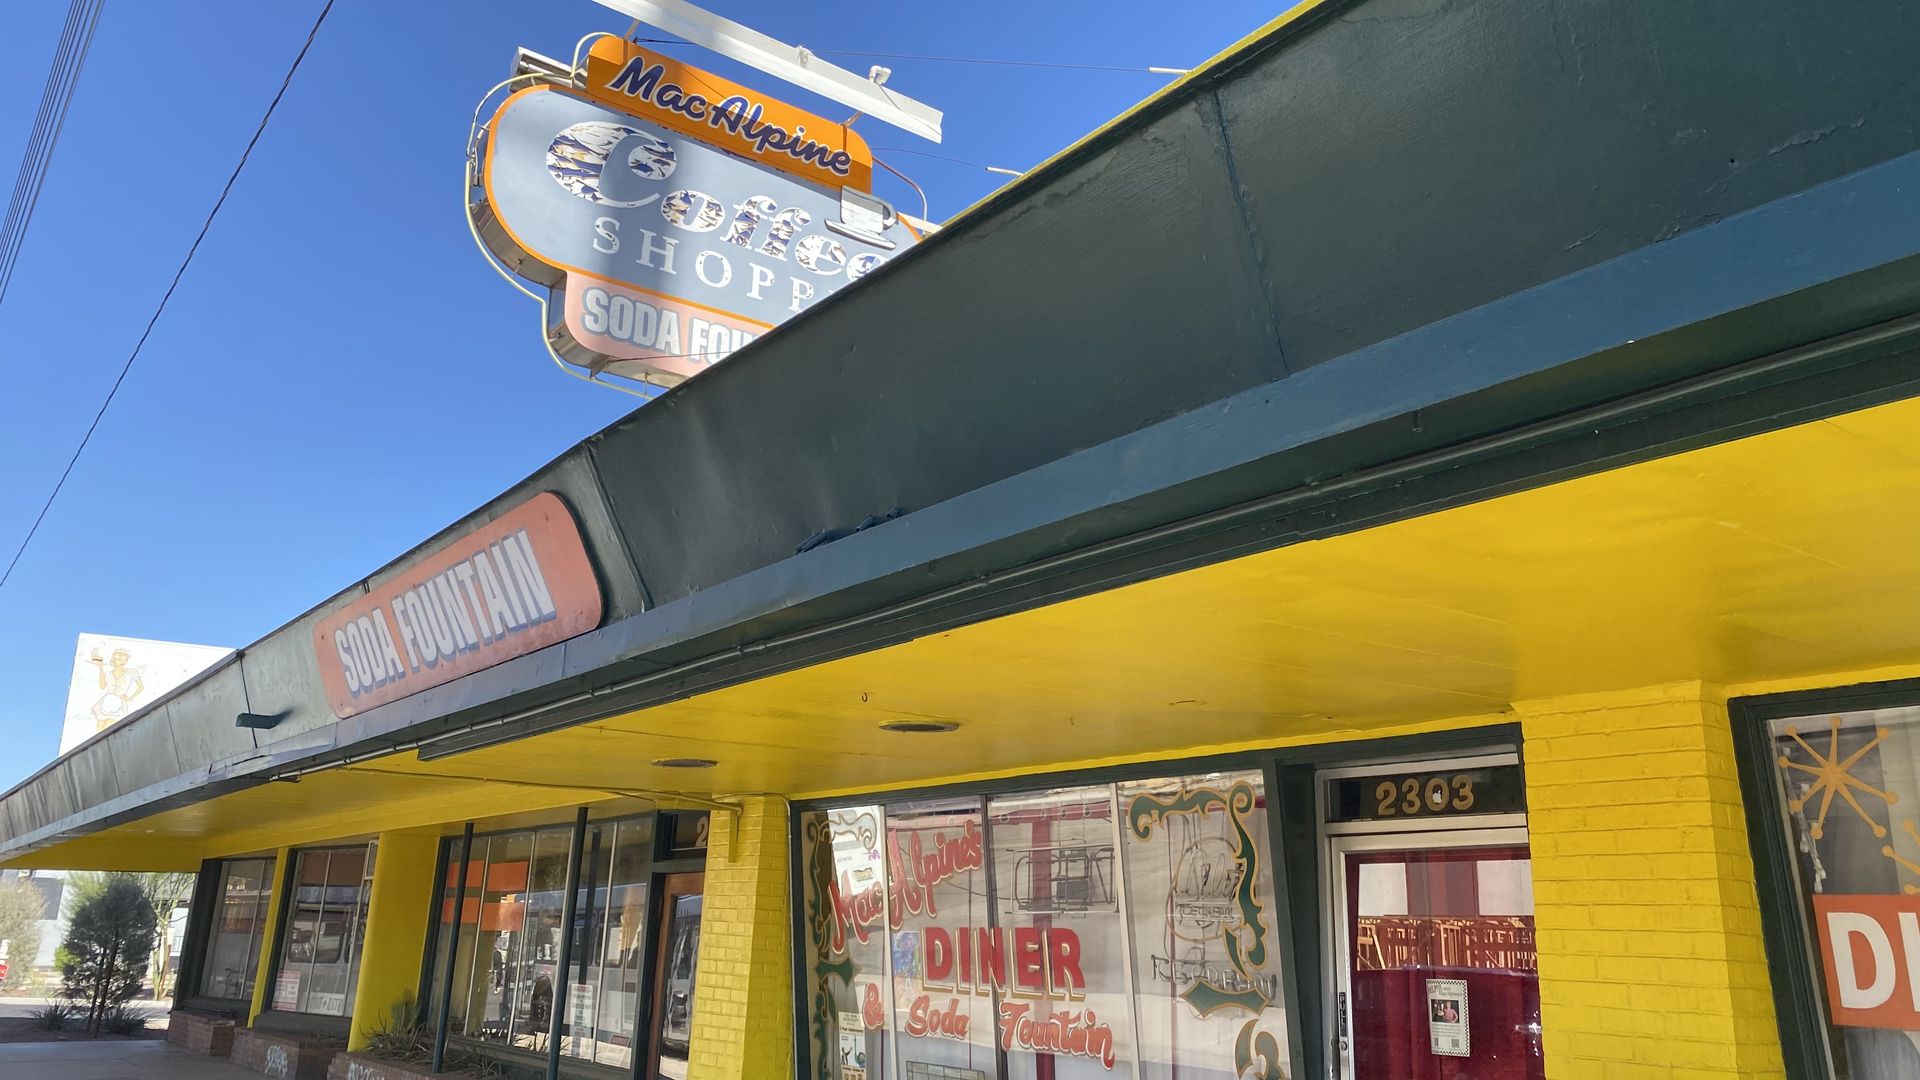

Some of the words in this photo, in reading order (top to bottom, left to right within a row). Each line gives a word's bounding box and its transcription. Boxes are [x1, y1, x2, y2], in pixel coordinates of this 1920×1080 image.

[592, 216, 837, 313] SHOPP
[581, 285, 683, 357] SODA
[333, 606, 406, 696] SODA
[391, 528, 557, 669] FOUNTAIN
[1375, 774, 1475, 815] 2303
[922, 926, 1086, 1001] DINER
[862, 983, 885, 1030] &
[905, 995, 970, 1040] Soda
[999, 1001, 1116, 1071] Fountain
